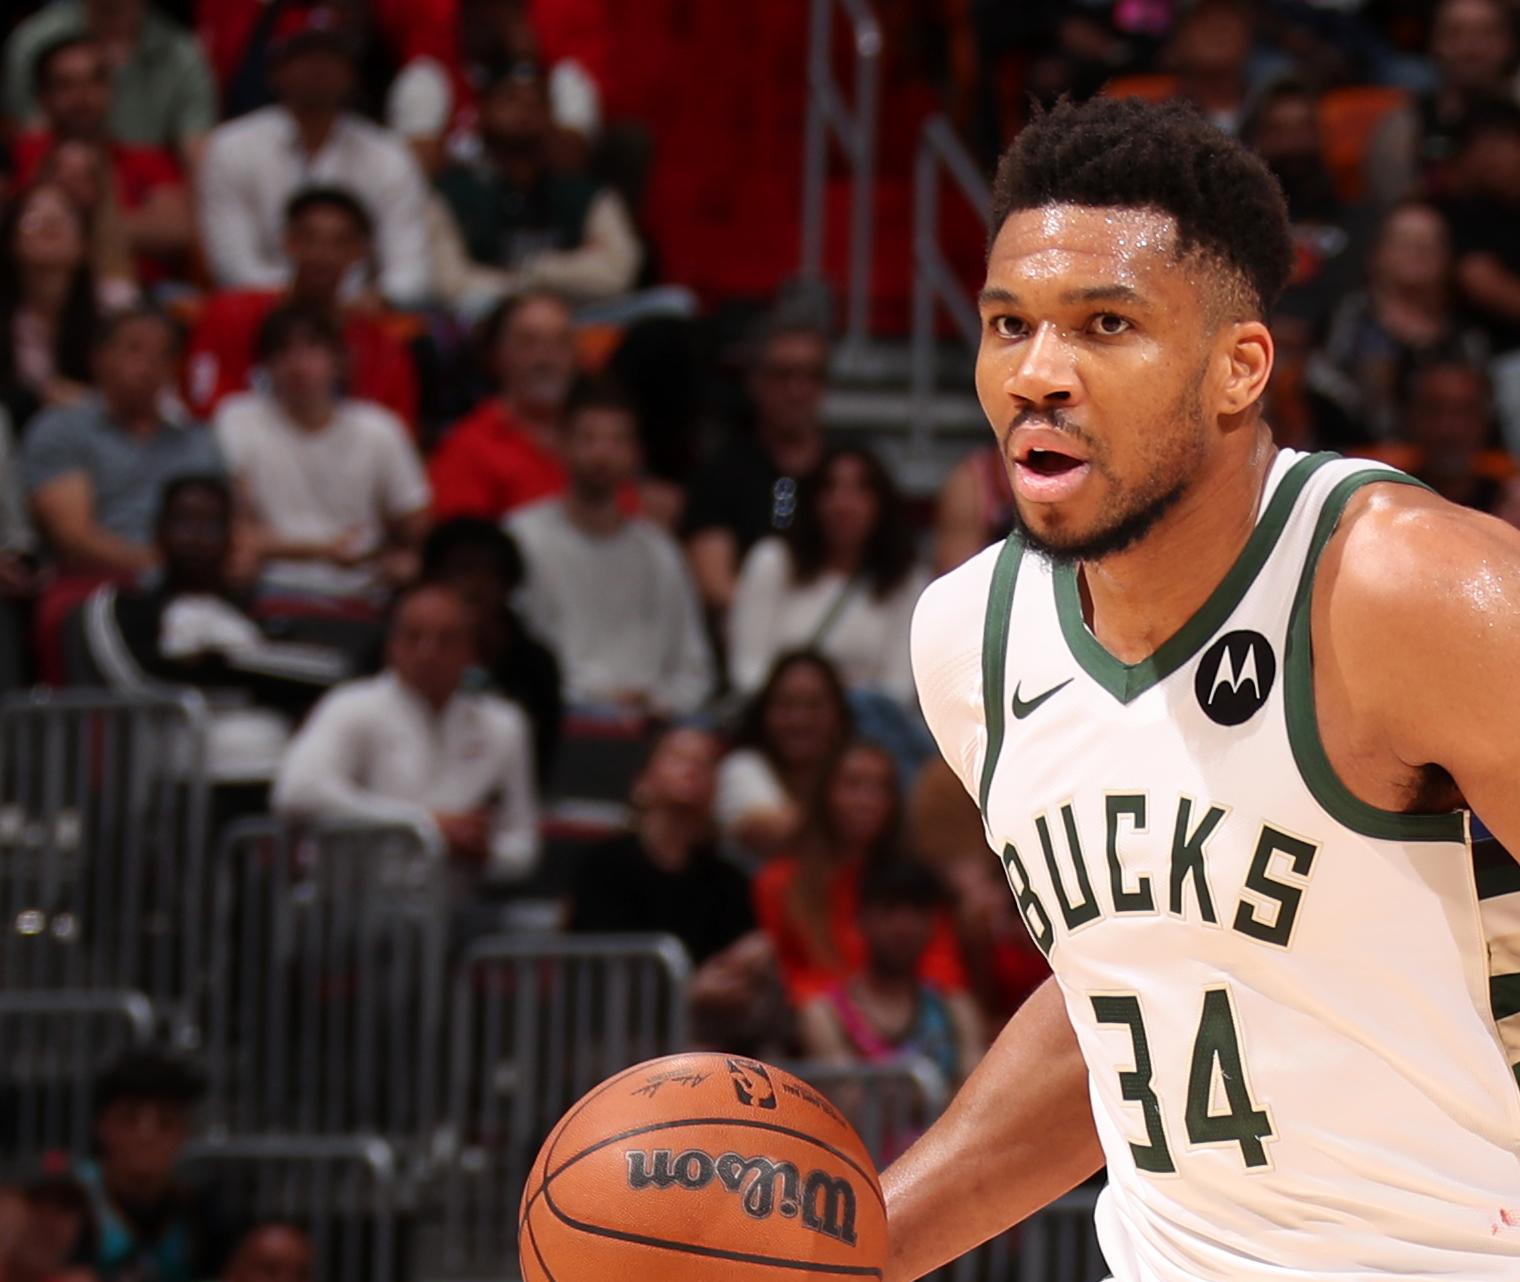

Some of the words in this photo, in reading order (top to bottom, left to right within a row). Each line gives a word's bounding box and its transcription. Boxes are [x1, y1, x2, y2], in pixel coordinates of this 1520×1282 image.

[1001, 788, 1325, 961] BUCKS
[1086, 982, 1280, 1180] 34
[625, 1148, 858, 1248] Wilson
